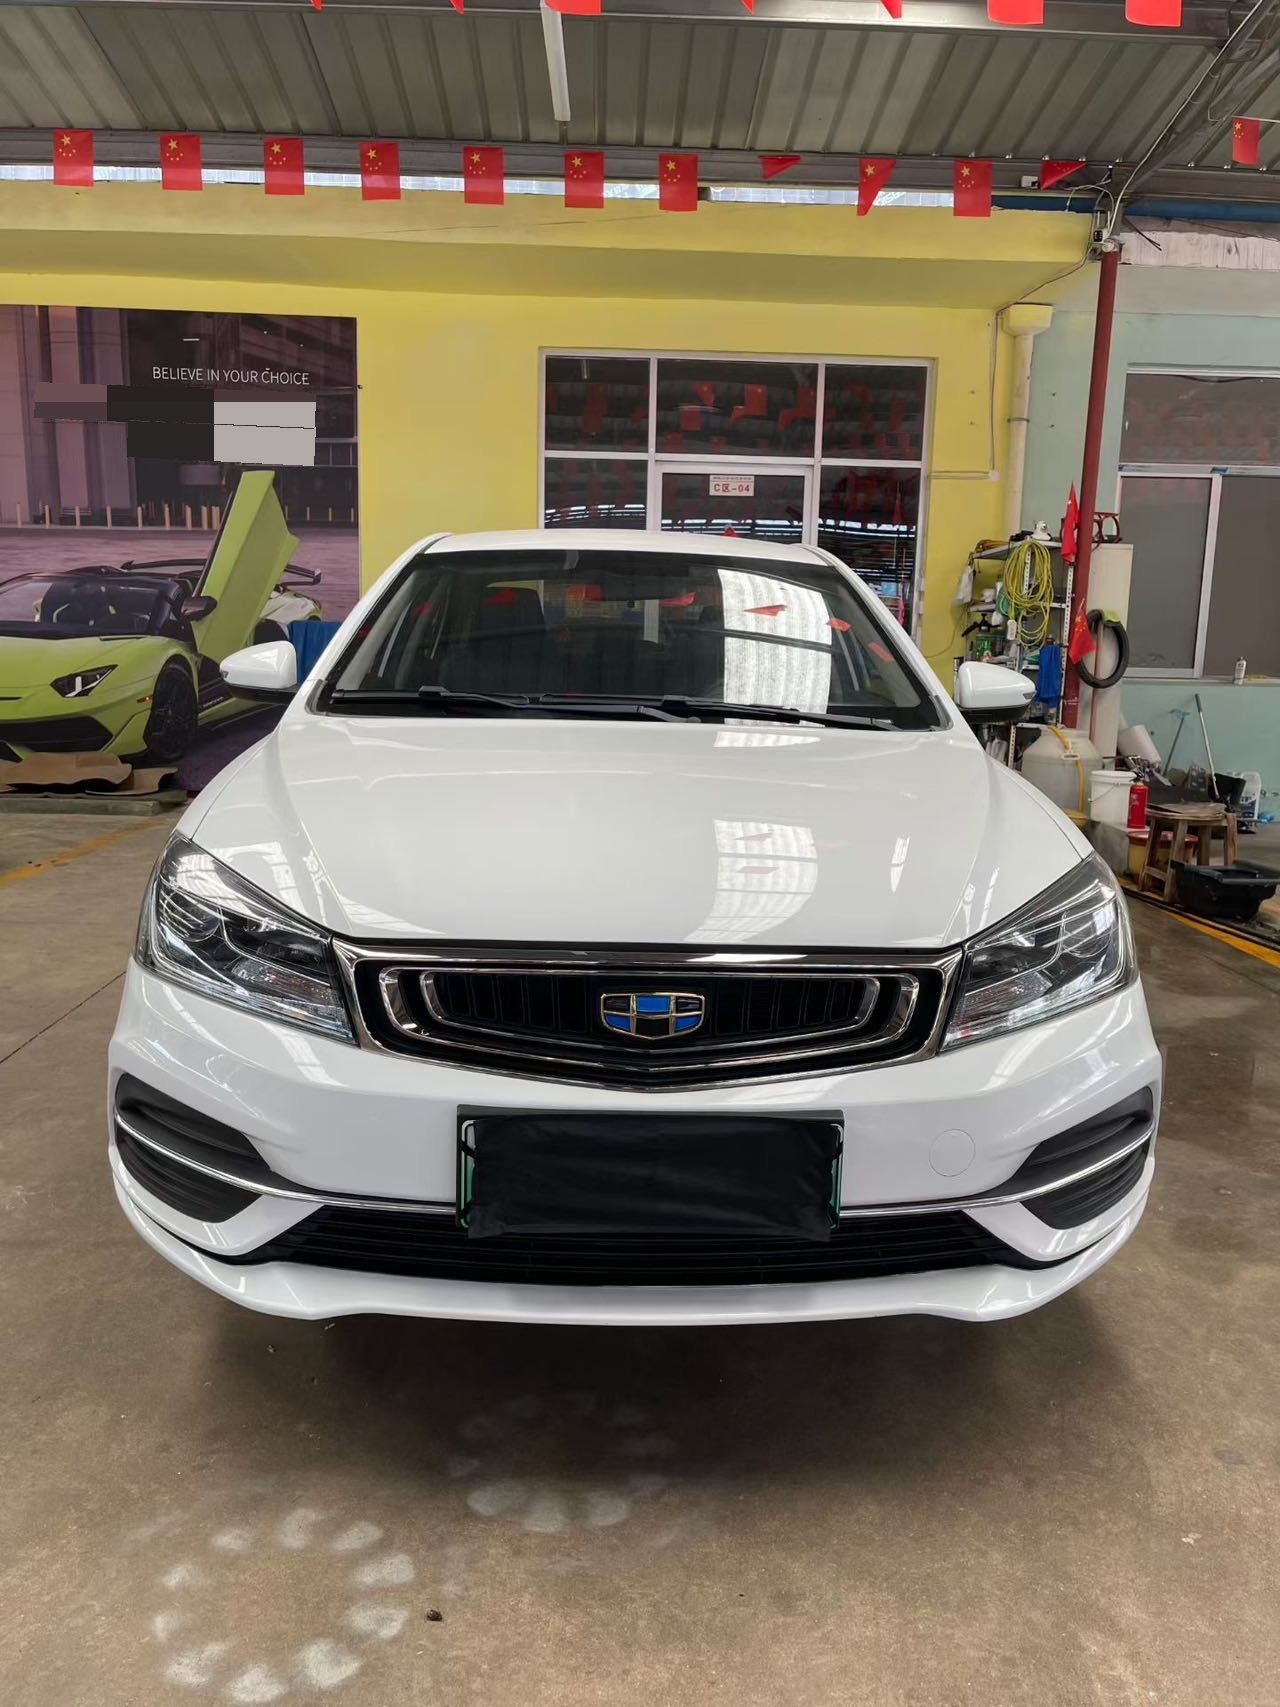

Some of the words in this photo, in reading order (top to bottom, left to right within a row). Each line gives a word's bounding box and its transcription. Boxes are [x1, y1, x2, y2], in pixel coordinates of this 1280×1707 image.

[152, 366, 204, 381] BELIEVE
[207, 368, 220, 382] IN
[222, 369, 258, 383] YOUR
[261, 370, 310, 385] CHOICE
[713, 483, 750, 493] C区-04
